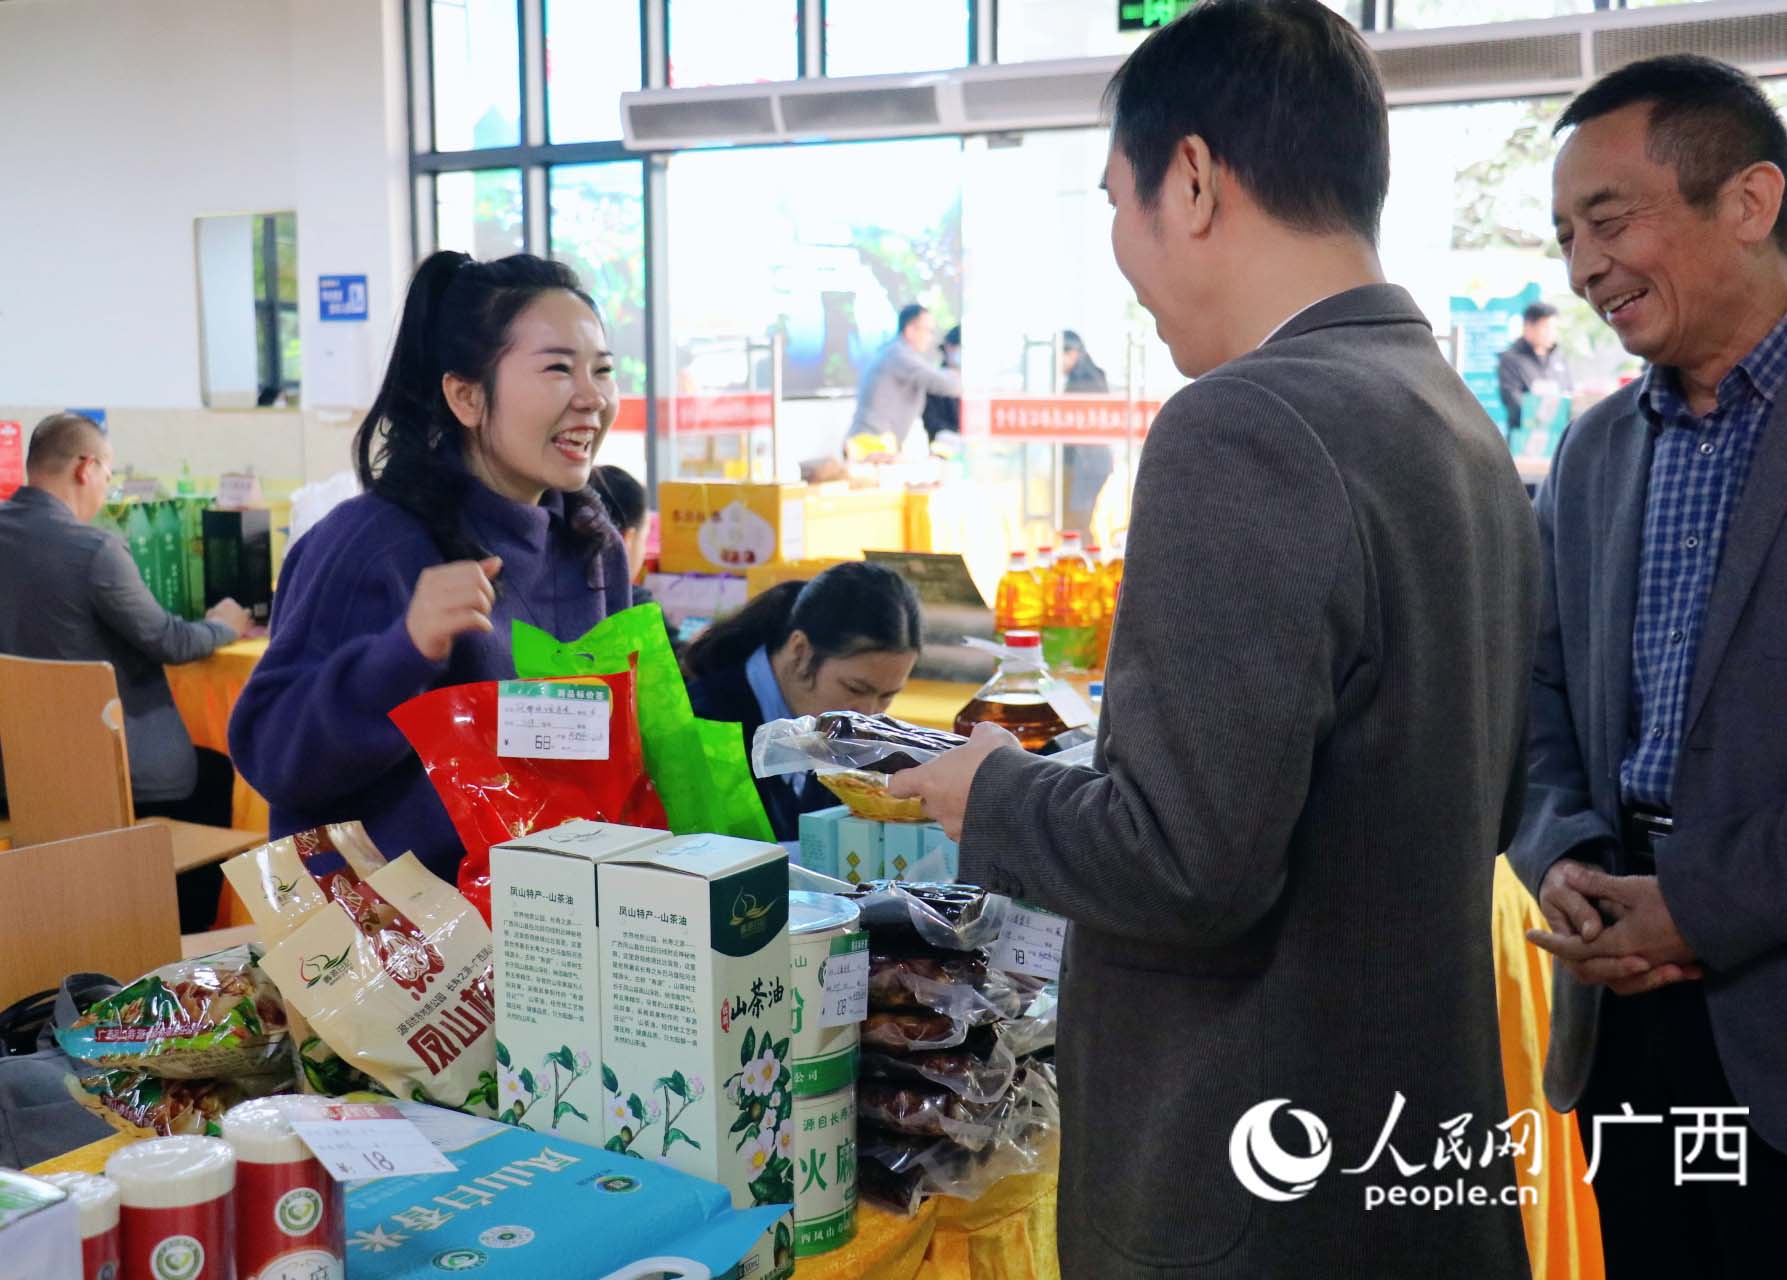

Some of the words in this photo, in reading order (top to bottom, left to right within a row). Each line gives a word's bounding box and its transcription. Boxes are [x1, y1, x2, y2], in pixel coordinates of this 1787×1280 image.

[730, 976, 785, 1021] 山茶油
[363, 1150, 395, 1172] 18
